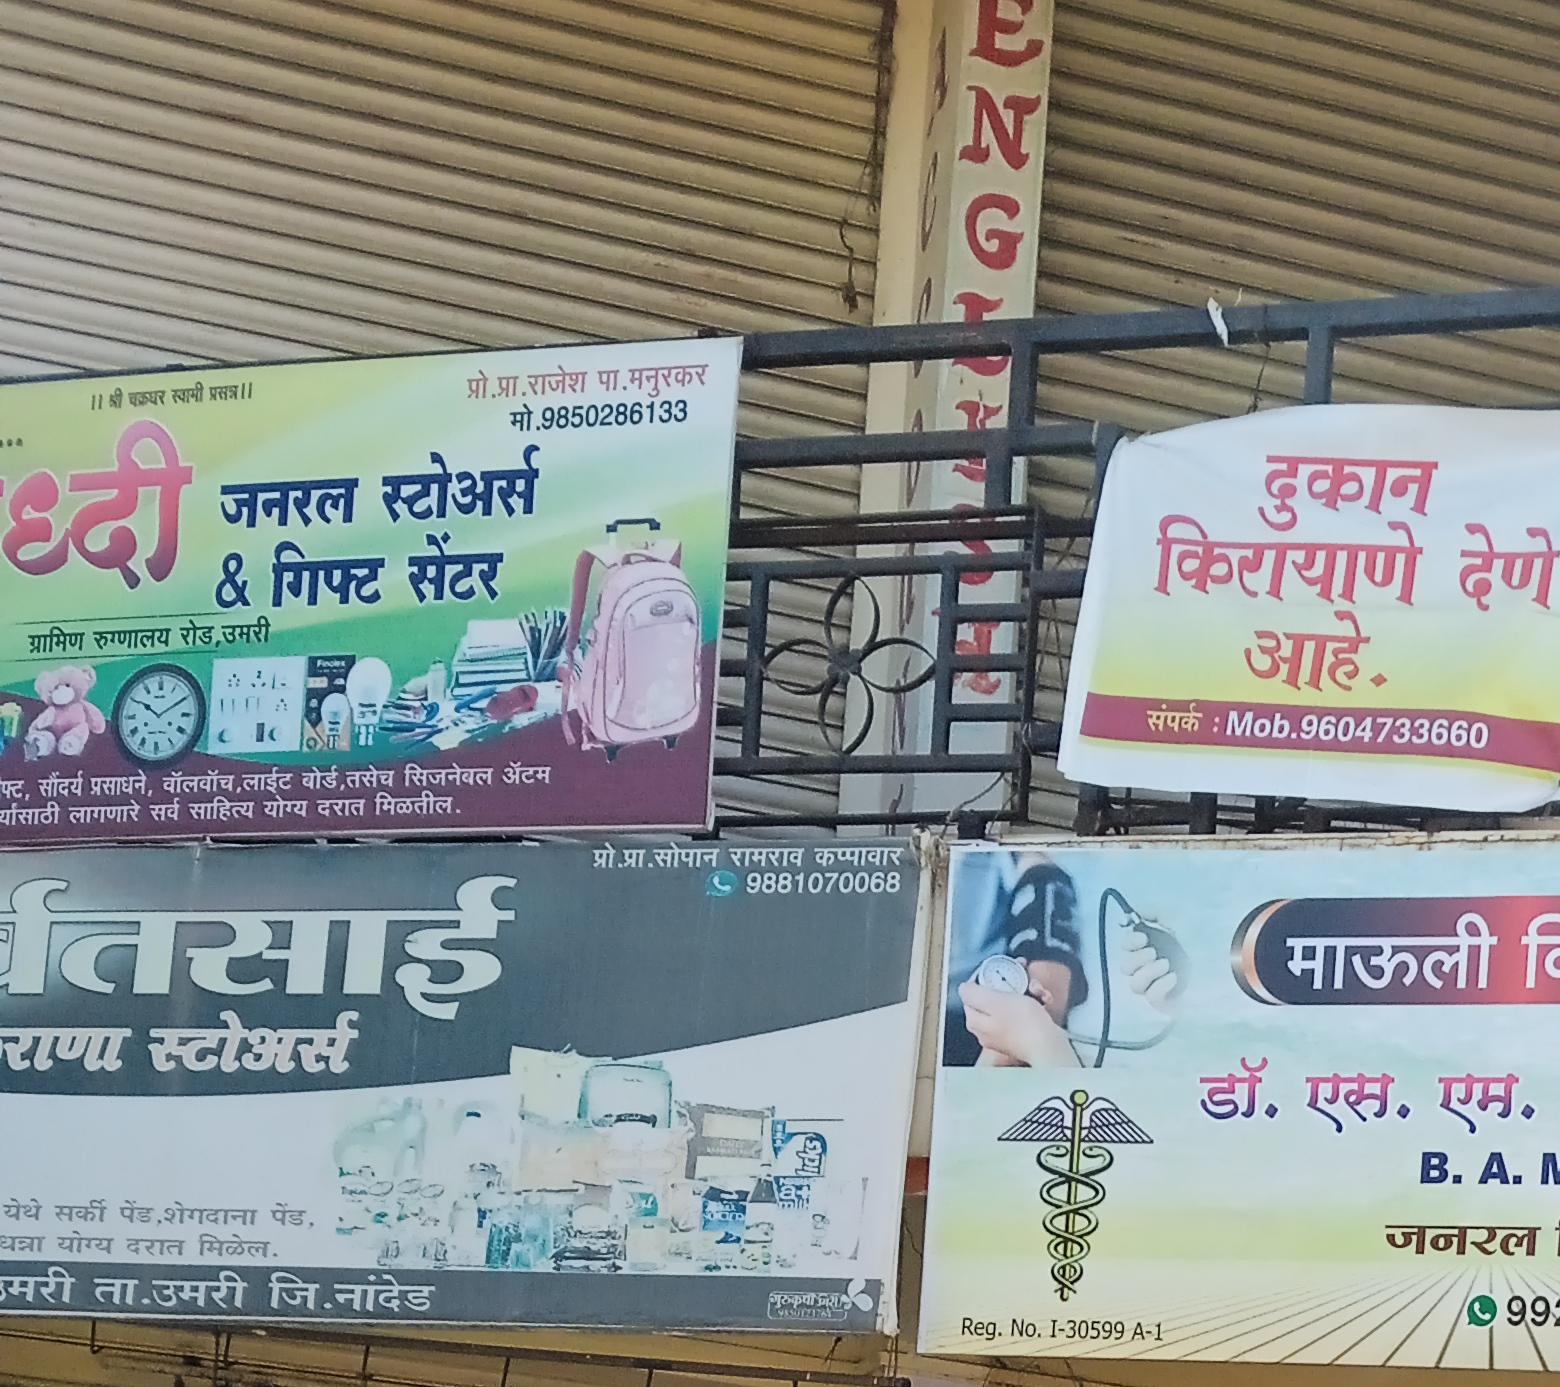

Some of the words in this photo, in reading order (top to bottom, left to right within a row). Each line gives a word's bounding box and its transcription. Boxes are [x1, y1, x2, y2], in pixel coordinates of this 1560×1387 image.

[171, 381, 205, 404] स्वामी
[598, 363, 710, 397] पा.मनुरकर
[510, 399, 689, 432] मो.9850286133
[219, 476, 360, 530] जनरल
[381, 443, 541, 524] स्टोअर्स
[1257, 453, 1439, 532] दुकान
[0, 421, 193, 588] ध्दी
[215, 552, 251, 609] &
[271, 540, 386, 608] गिफ्ट
[407, 531, 504, 604] सेंटर
[1153, 514, 1424, 606] किरायाणे
[1459, 521, 1560, 612] देणे
[28, 626, 85, 654] ग्रामिण
[94, 626, 171, 652] रुग्णालय
[1243, 609, 1390, 692] आहे.
[1145, 702, 1203, 733] संपर्क
[1224, 709, 1489, 749] Mob.9604733660
[0, 775, 30, 801] फ्ट,
[38, 770, 84, 798] सौंदर्य
[69, 799, 141, 824] लागणारे
[150, 797, 180, 822] सर्व
[189, 795, 255, 820] साहित्य
[263, 797, 308, 819] योग्य
[316, 797, 365, 817] दरात
[591, 841, 720, 869] प्रो.प्रा.सोपान
[728, 846, 805, 868] रामराव
[814, 846, 905, 868] कप्पावार
[745, 872, 901, 895] 9881070068
[1286, 912, 1498, 990] माऊली
[0, 1026, 133, 1073] राणा
[148, 1010, 361, 1074] स्टोअर्स
[1199, 1056, 1280, 1121] डॉ.
[1305, 1071, 1411, 1134] एस.
[1438, 1071, 1536, 1134] एम.
[1420, 1150, 1462, 1185] B.
[1478, 1152, 1523, 1186] A.
[3, 1197, 43, 1222] येथे
[57, 1230, 115, 1255] योग्य
[126, 1239, 186, 1257] दरात
[199, 1234, 279, 1259] मिळेल.
[1385, 1223, 1542, 1258] जनरल
[94, 1270, 248, 1310] ता.उमरी
[268, 1270, 437, 1313] जि.नांदेड
[961, 1317, 1003, 1341] Reg.
[1010, 1317, 1042, 1338] No.
[1049, 1318, 1125, 1341] I-30599
[1131, 1321, 1164, 1342] A-1
